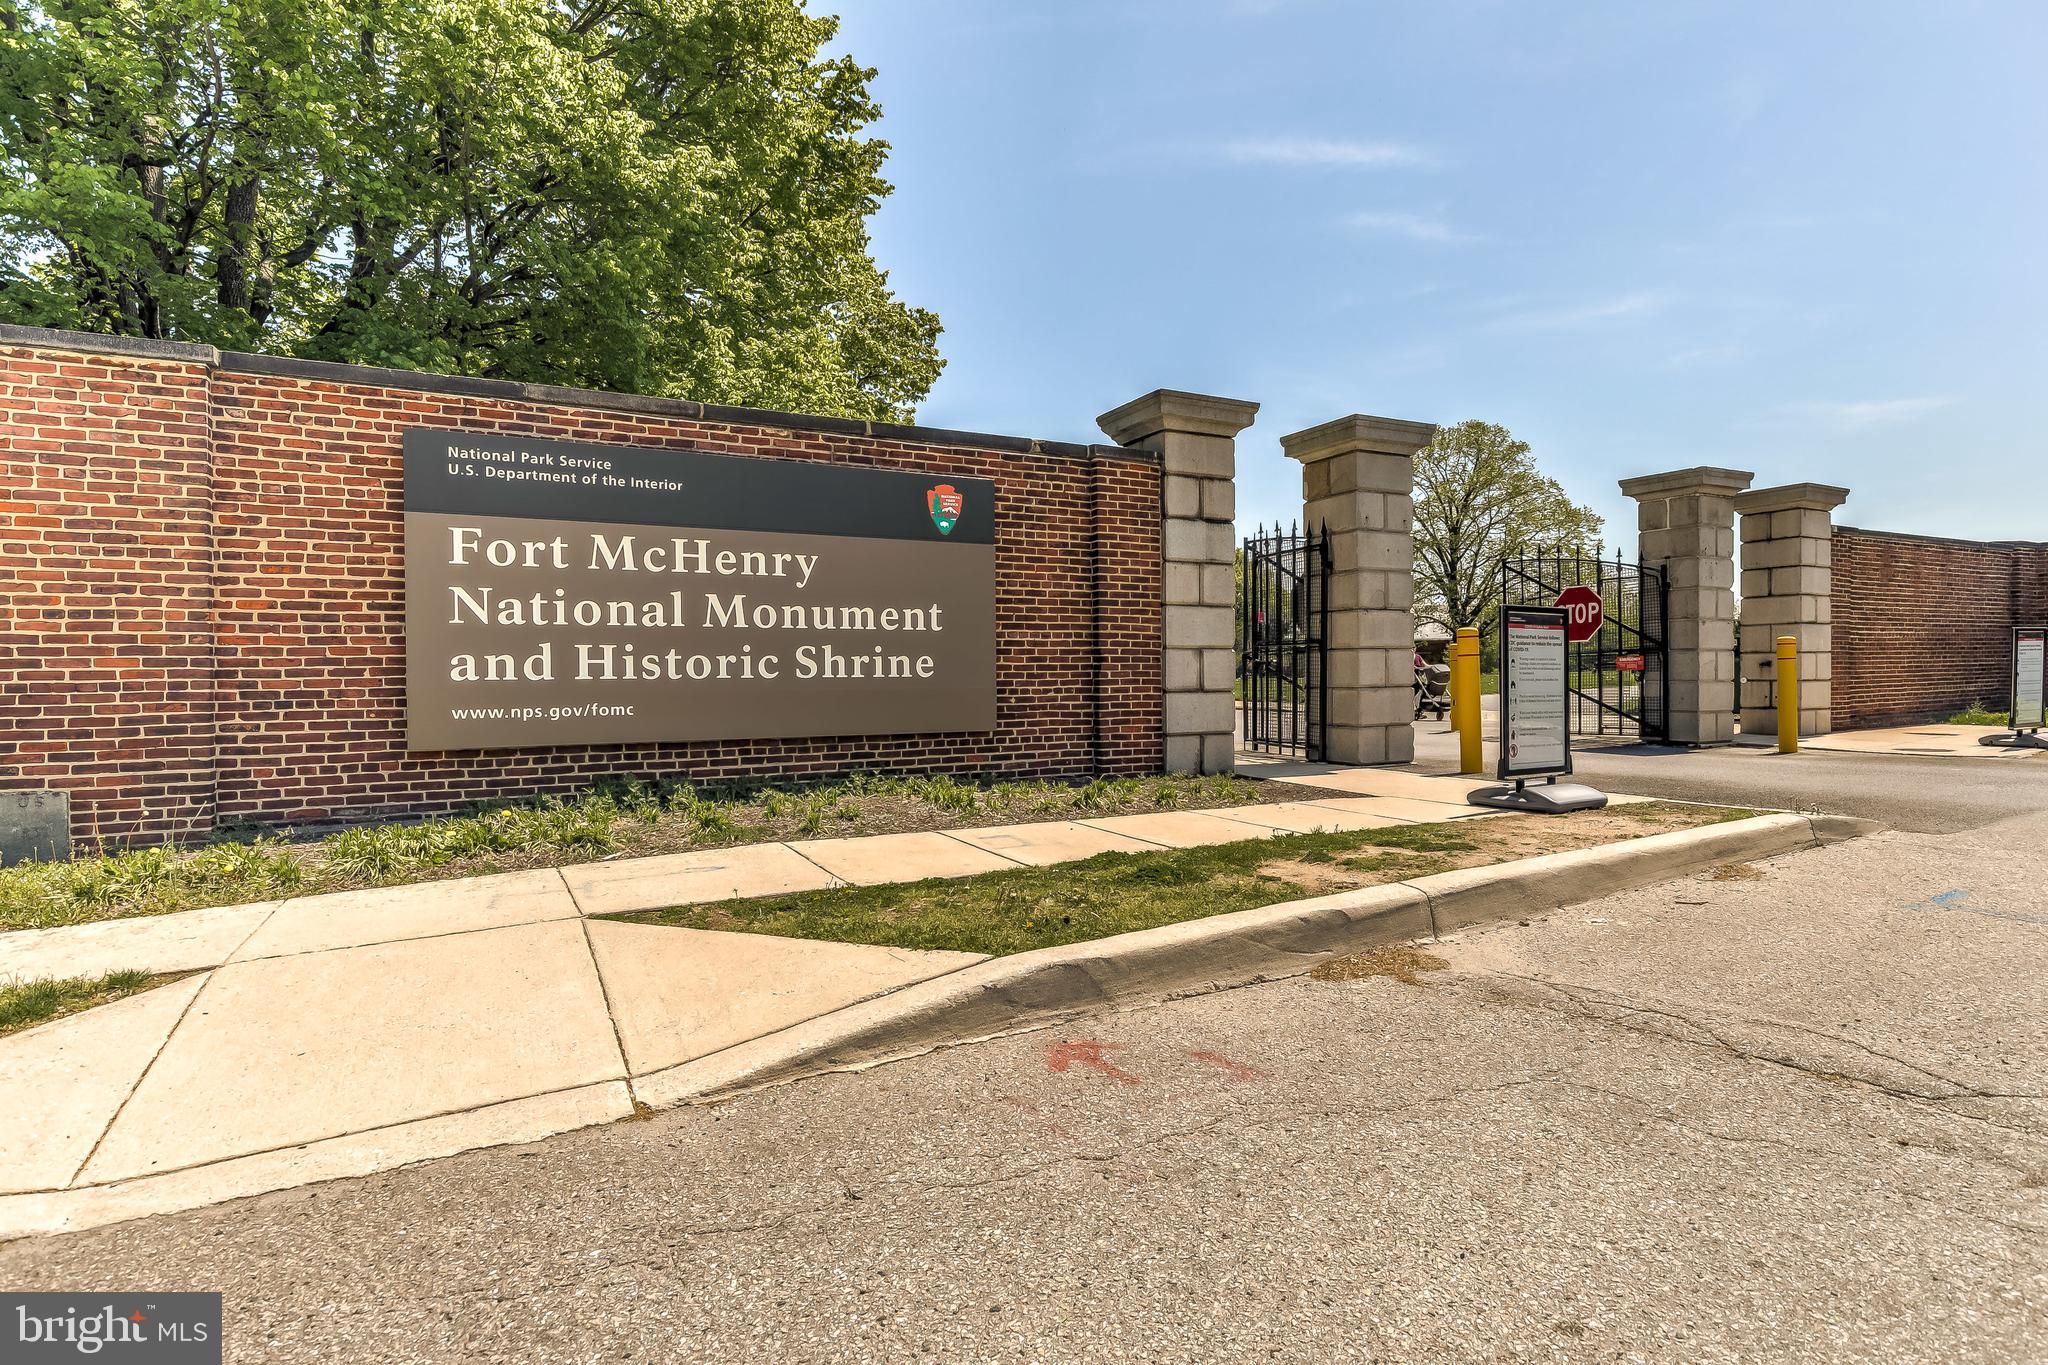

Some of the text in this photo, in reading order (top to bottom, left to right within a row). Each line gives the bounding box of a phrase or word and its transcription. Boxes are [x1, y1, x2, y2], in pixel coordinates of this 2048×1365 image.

[448, 446, 612, 469] National Park Service
[448, 464, 683, 490] U.S. Department of the Interior
[447, 527, 819, 589] Fort McHenry
[448, 586, 943, 632] National Monument
[1558, 602, 1599, 624] TOP
[449, 642, 936, 683] and Historic Shrine
[450, 702, 635, 722] www.nps.gov/fomc
